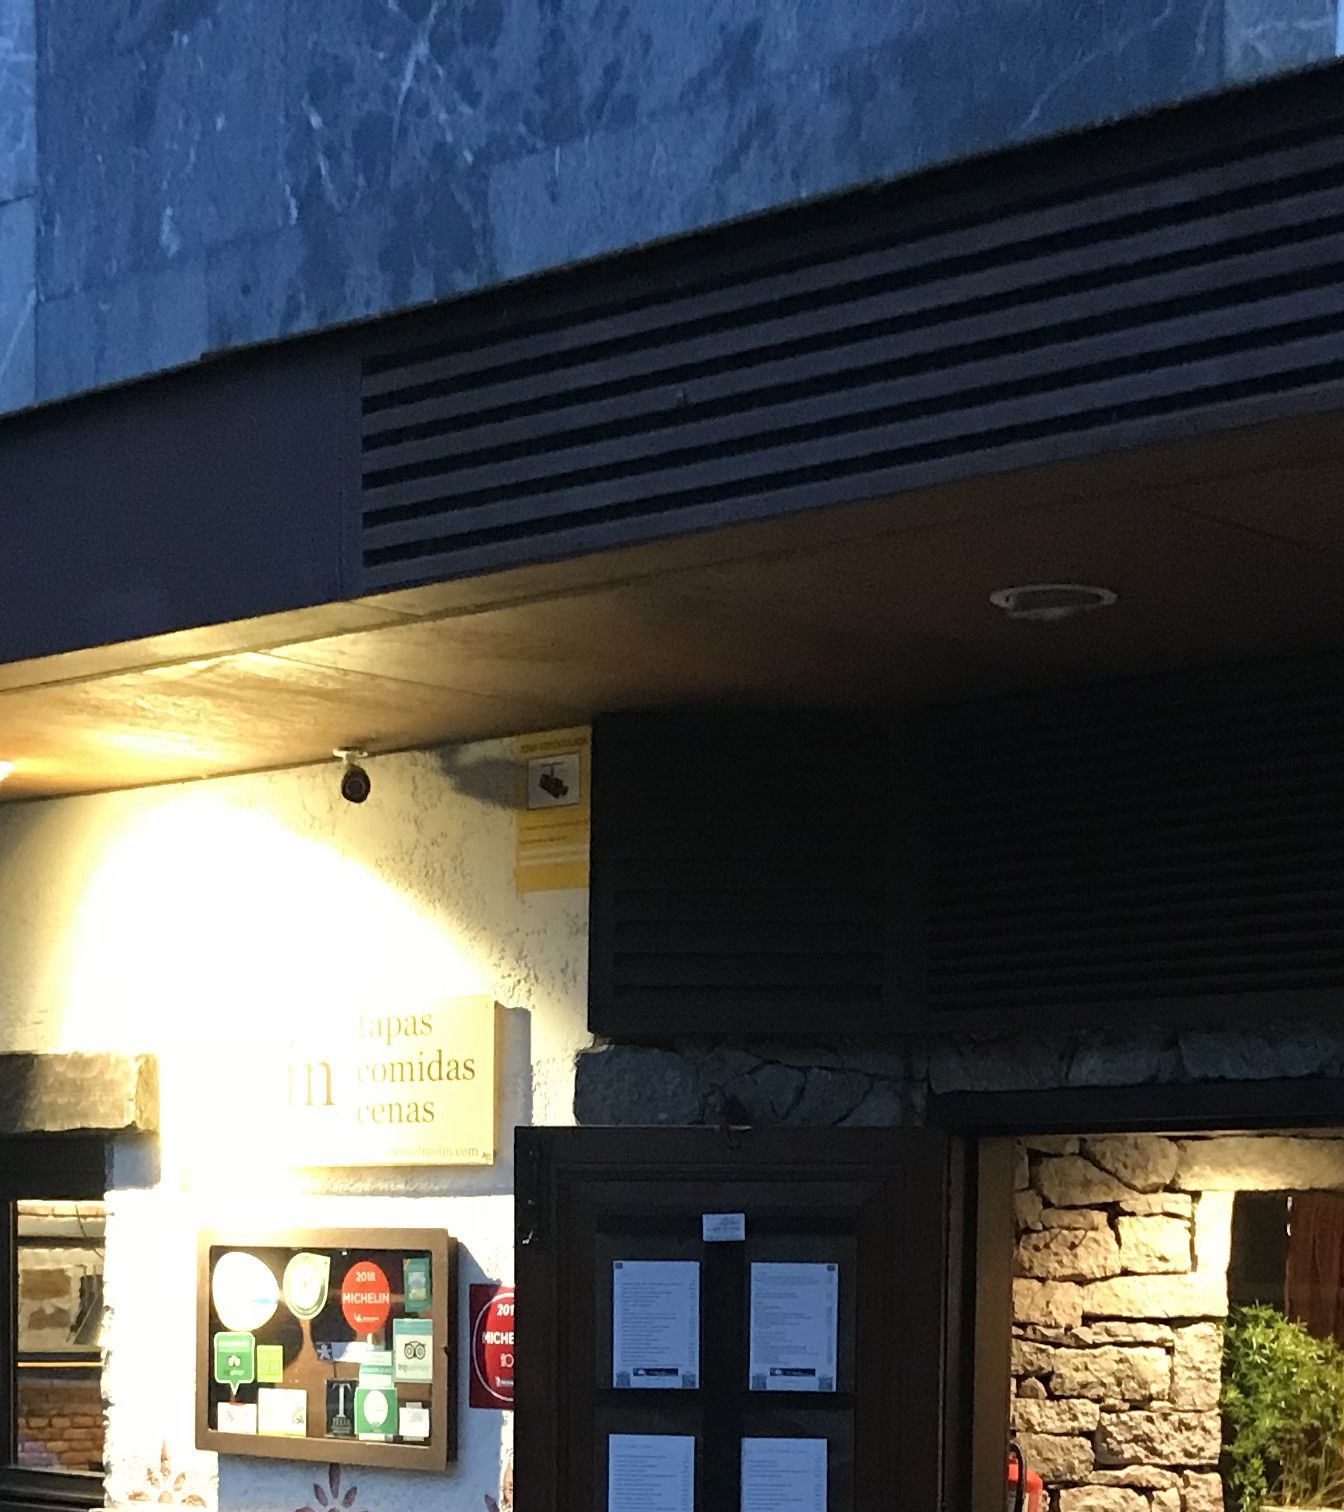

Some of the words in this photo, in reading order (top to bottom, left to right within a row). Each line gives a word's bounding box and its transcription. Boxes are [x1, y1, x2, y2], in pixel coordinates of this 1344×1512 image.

[358, 1010, 433, 1046] tapas
[357, 1048, 476, 1083] comidas
[357, 1099, 435, 1124] cenas
[342, 1292, 389, 1304] MICHELIN
[497, 1303, 515, 1316] 201
[482, 1331, 515, 1345] MICHE
